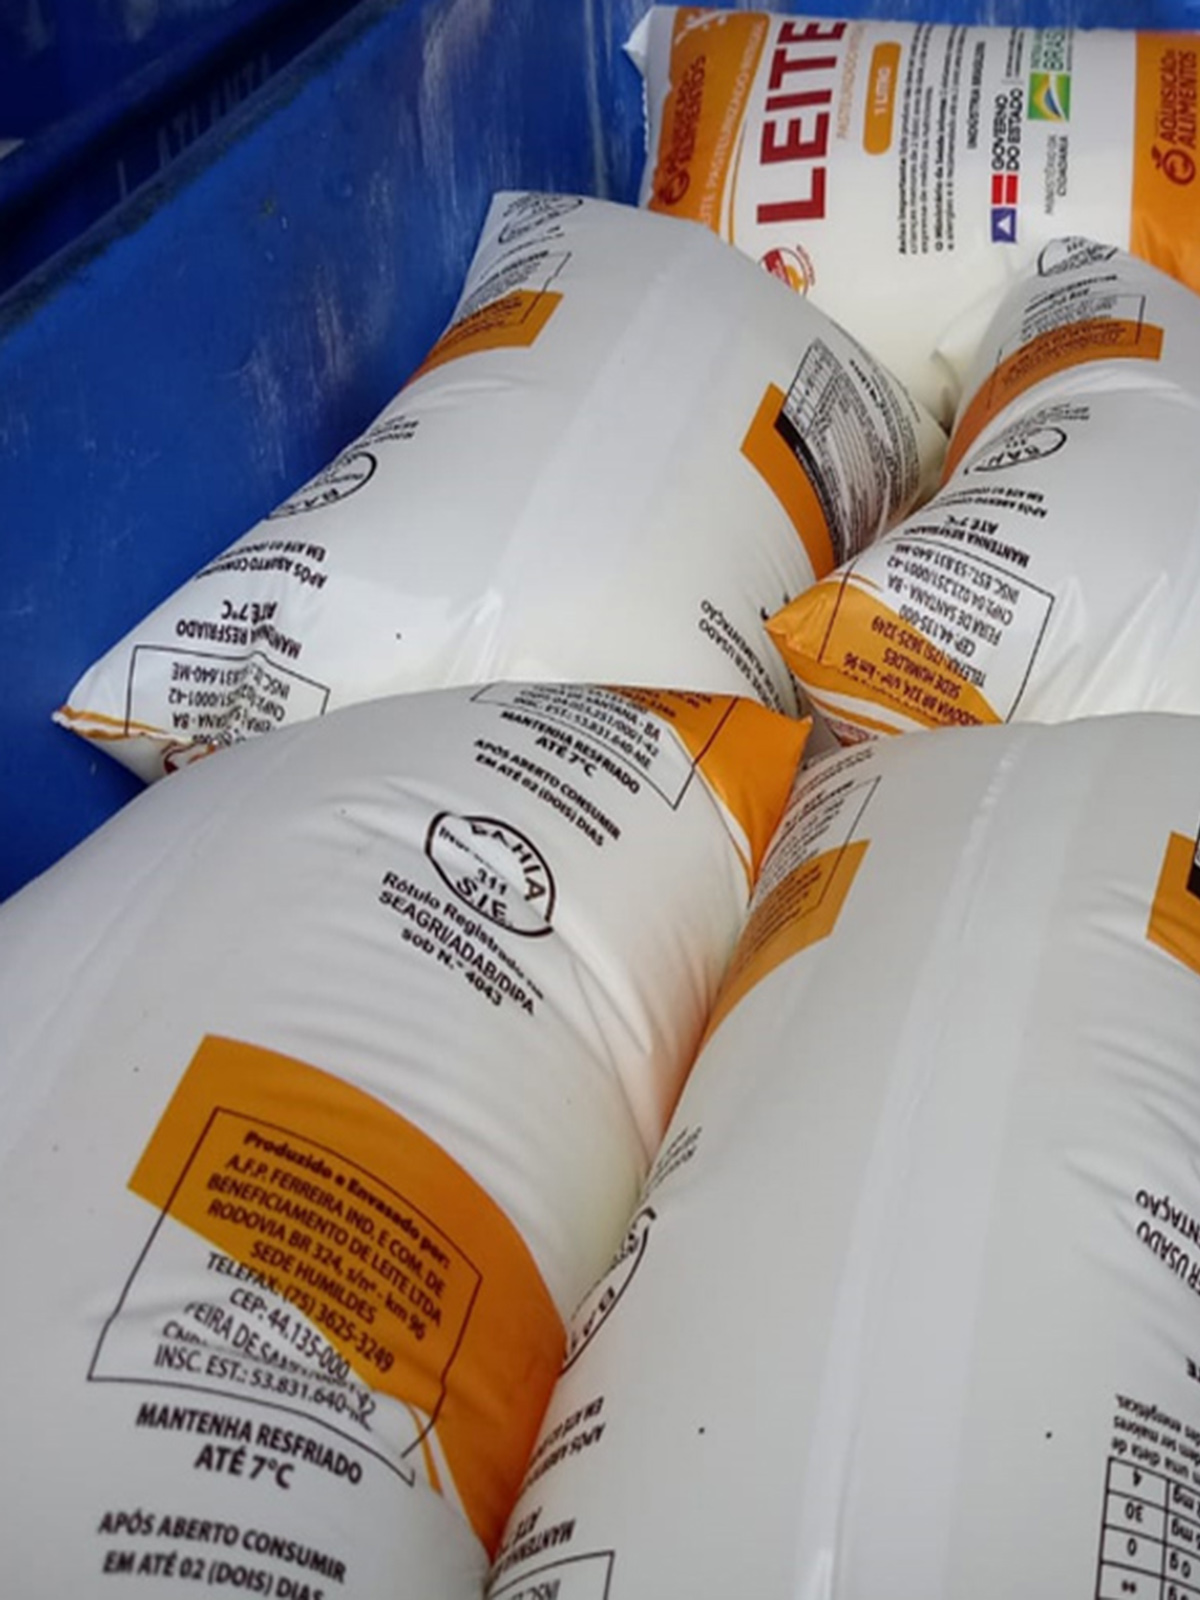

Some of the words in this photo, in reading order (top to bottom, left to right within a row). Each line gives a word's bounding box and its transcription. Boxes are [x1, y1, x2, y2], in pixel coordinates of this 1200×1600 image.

[756, 21, 848, 224] LEITE
[991, 94, 1007, 171] GOVERNO
[1006, 88, 1023, 142] ESTADO
[1178, 50, 1196, 150] ALIMENTOS
[1006, 144, 1021, 171] DO
[176, 619, 248, 645] RESFRIADO
[501, 710, 573, 746] MANTENHA
[574, 740, 641, 795] RESFRIADO
[535, 736, 566, 759] ATÉ
[474, 739, 509, 759] APÓS
[510, 754, 561, 788] ABERTO
[560, 783, 622, 841] CONSUMIR
[475, 753, 497, 769] EM
[498, 763, 522, 781] ATÉ
[521, 777, 539, 792] 02
[538, 787, 578, 823] (DOIS)
[576, 817, 605, 847] DIAS
[382, 871, 441, 910] Rótulo
[378, 890, 535, 1017] SEAGRI/ADAB/DIPA
[402, 927, 435, 955] sob
[465, 971, 503, 1007] 4043
[243, 1130, 334, 1180] Produzido
[335, 1175, 345, 1186] e
[346, 1177, 421, 1240] Envasado
[206, 1172, 349, 1246] BENEFICIAMENTO
[348, 1241, 372, 1263] DE
[371, 1253, 411, 1294] LEITE
[409, 1287, 442, 1327] LTDA
[225, 1153, 268, 1182] A.F.P.
[270, 1168, 344, 1217] FERREIRA
[345, 1208, 376, 1241] IND.
[377, 1229, 390, 1248] E
[388, 1238, 424, 1278] COM.
[424, 1271, 447, 1299] DE
[1136, 1220, 1189, 1280] USADO
[207, 1199, 286, 1241] RODOVIA
[288, 1231, 313, 1252] BR
[312, 1245, 344, 1275] 324,
[385, 1292, 408, 1322] km
[408, 1314, 426, 1340] 96
[251, 1240, 294, 1274] SEDE
[294, 1260, 378, 1325] HUMILDES
[206, 1251, 281, 1297] TELEFAX:
[282, 1284, 317, 1317] (75)
[316, 1304, 395, 1374] 3625-3249
[229, 1287, 268, 1321] CEP:
[267, 1308, 351, 1379] 44.135-000
[154, 1343, 200, 1373] INSC.
[205, 1355, 248, 1383] EST.:
[135, 1402, 253, 1444] MANTENHA
[255, 1423, 364, 1485] RESFRIADO
[194, 1443, 247, 1477] ATÉ
[249, 1454, 295, 1490] 7°C
[98, 1507, 156, 1536] APÓS
[156, 1514, 240, 1546] ABERTO
[242, 1529, 347, 1584] CONSUMIR
[1125, 1502, 1144, 1524] 30
[1126, 1538, 1138, 1557] 0
[102, 1550, 137, 1574] EM
[137, 1550, 178, 1577] ATÉ
[179, 1557, 207, 1582] 02
[207, 1560, 275, 1597] (DOIS)
